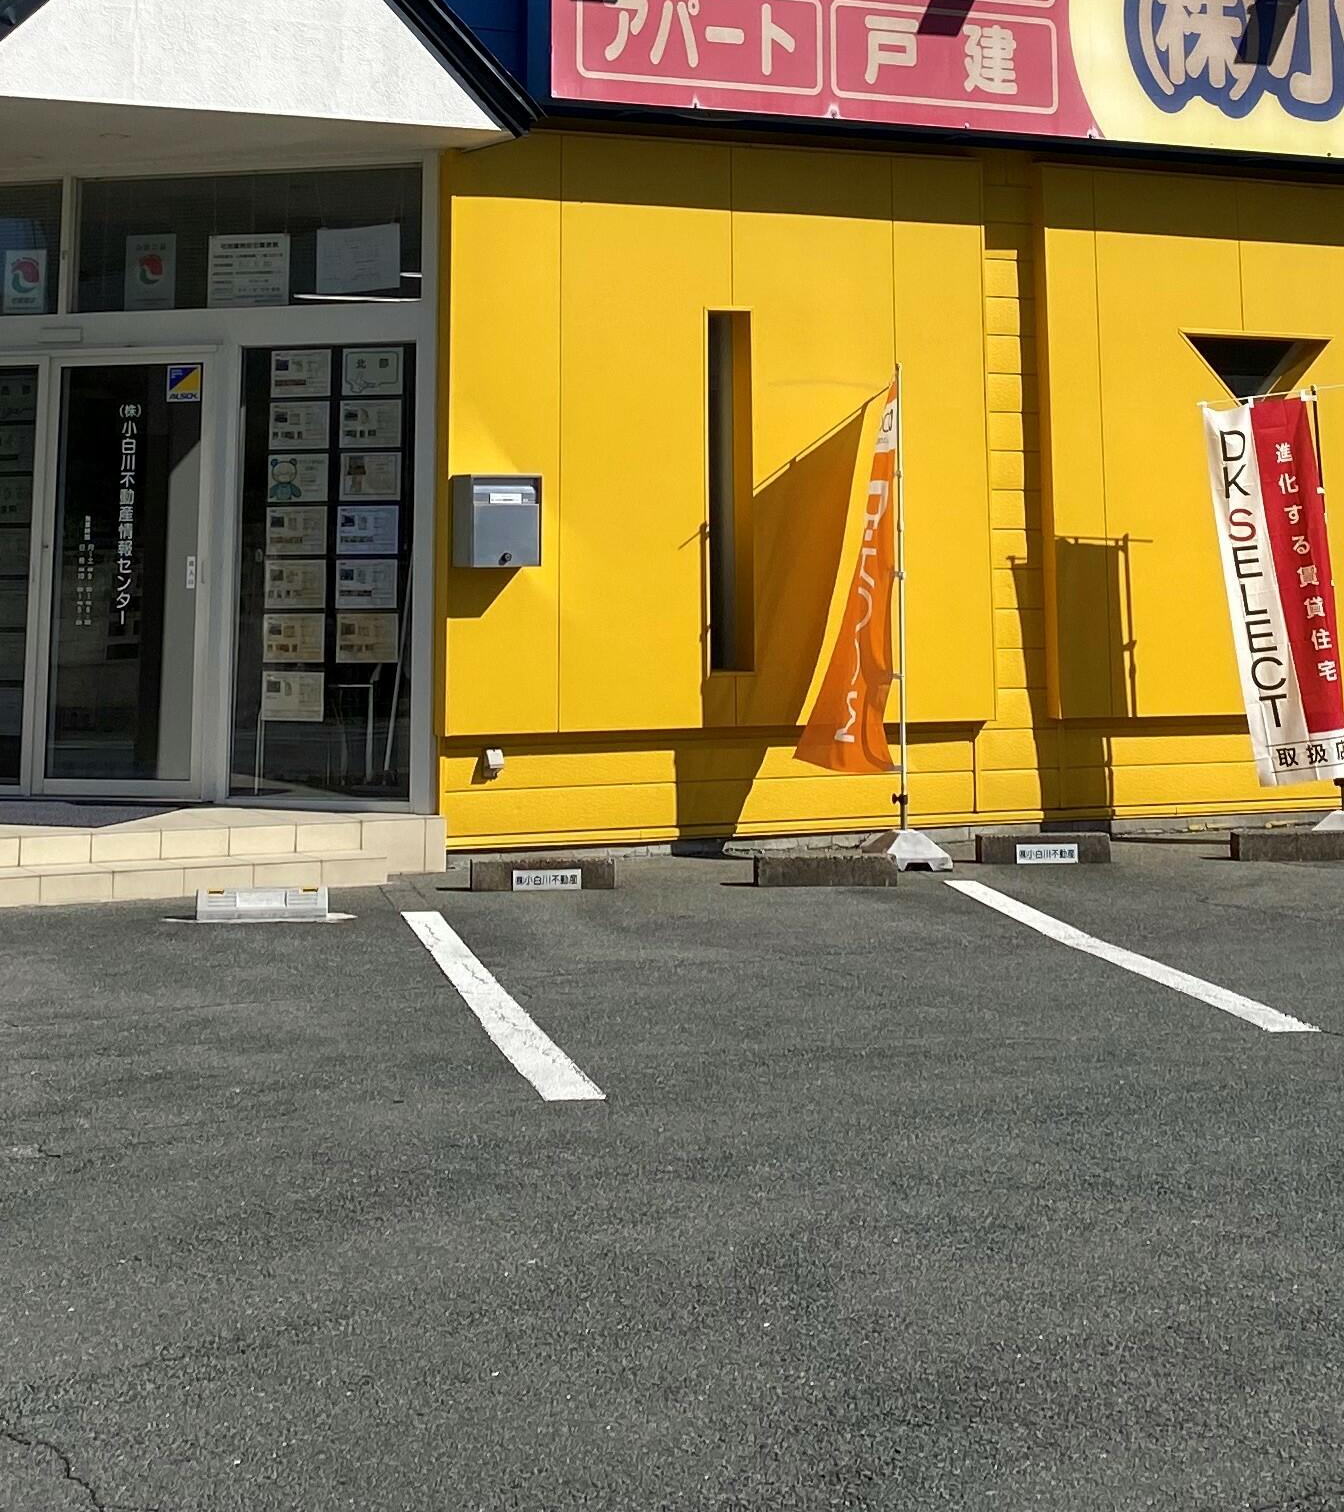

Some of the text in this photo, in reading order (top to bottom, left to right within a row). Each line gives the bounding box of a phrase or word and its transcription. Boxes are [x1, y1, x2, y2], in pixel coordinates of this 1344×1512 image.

[864, 14, 1019, 96] 戸建
[1229, 508, 1288, 728] SELECT
[1274, 441, 1340, 683] 進化する賃貸住宅
